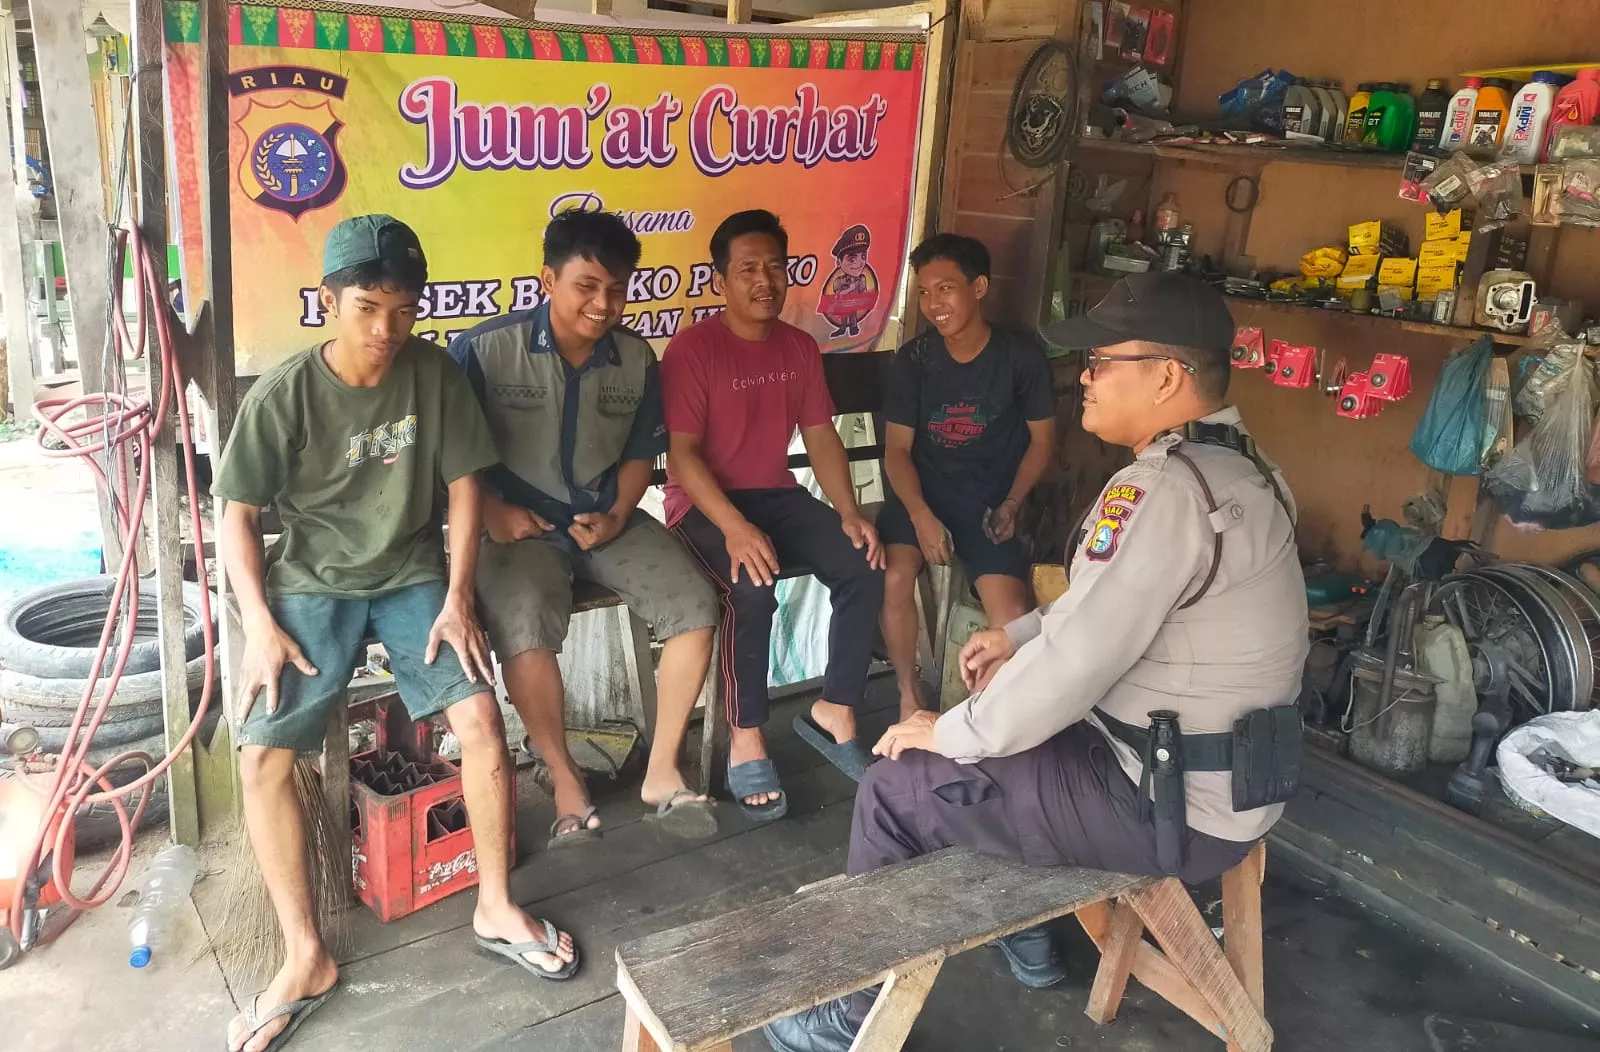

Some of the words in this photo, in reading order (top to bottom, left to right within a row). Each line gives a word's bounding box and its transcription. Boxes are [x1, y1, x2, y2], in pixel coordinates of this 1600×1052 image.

[240, 72, 335, 91] RIAU
[399, 76, 684, 189] Jum'at
[688, 82, 888, 177] Curhat
[509, 275, 682, 313] BKO
[686, 253, 818, 298] PKO
